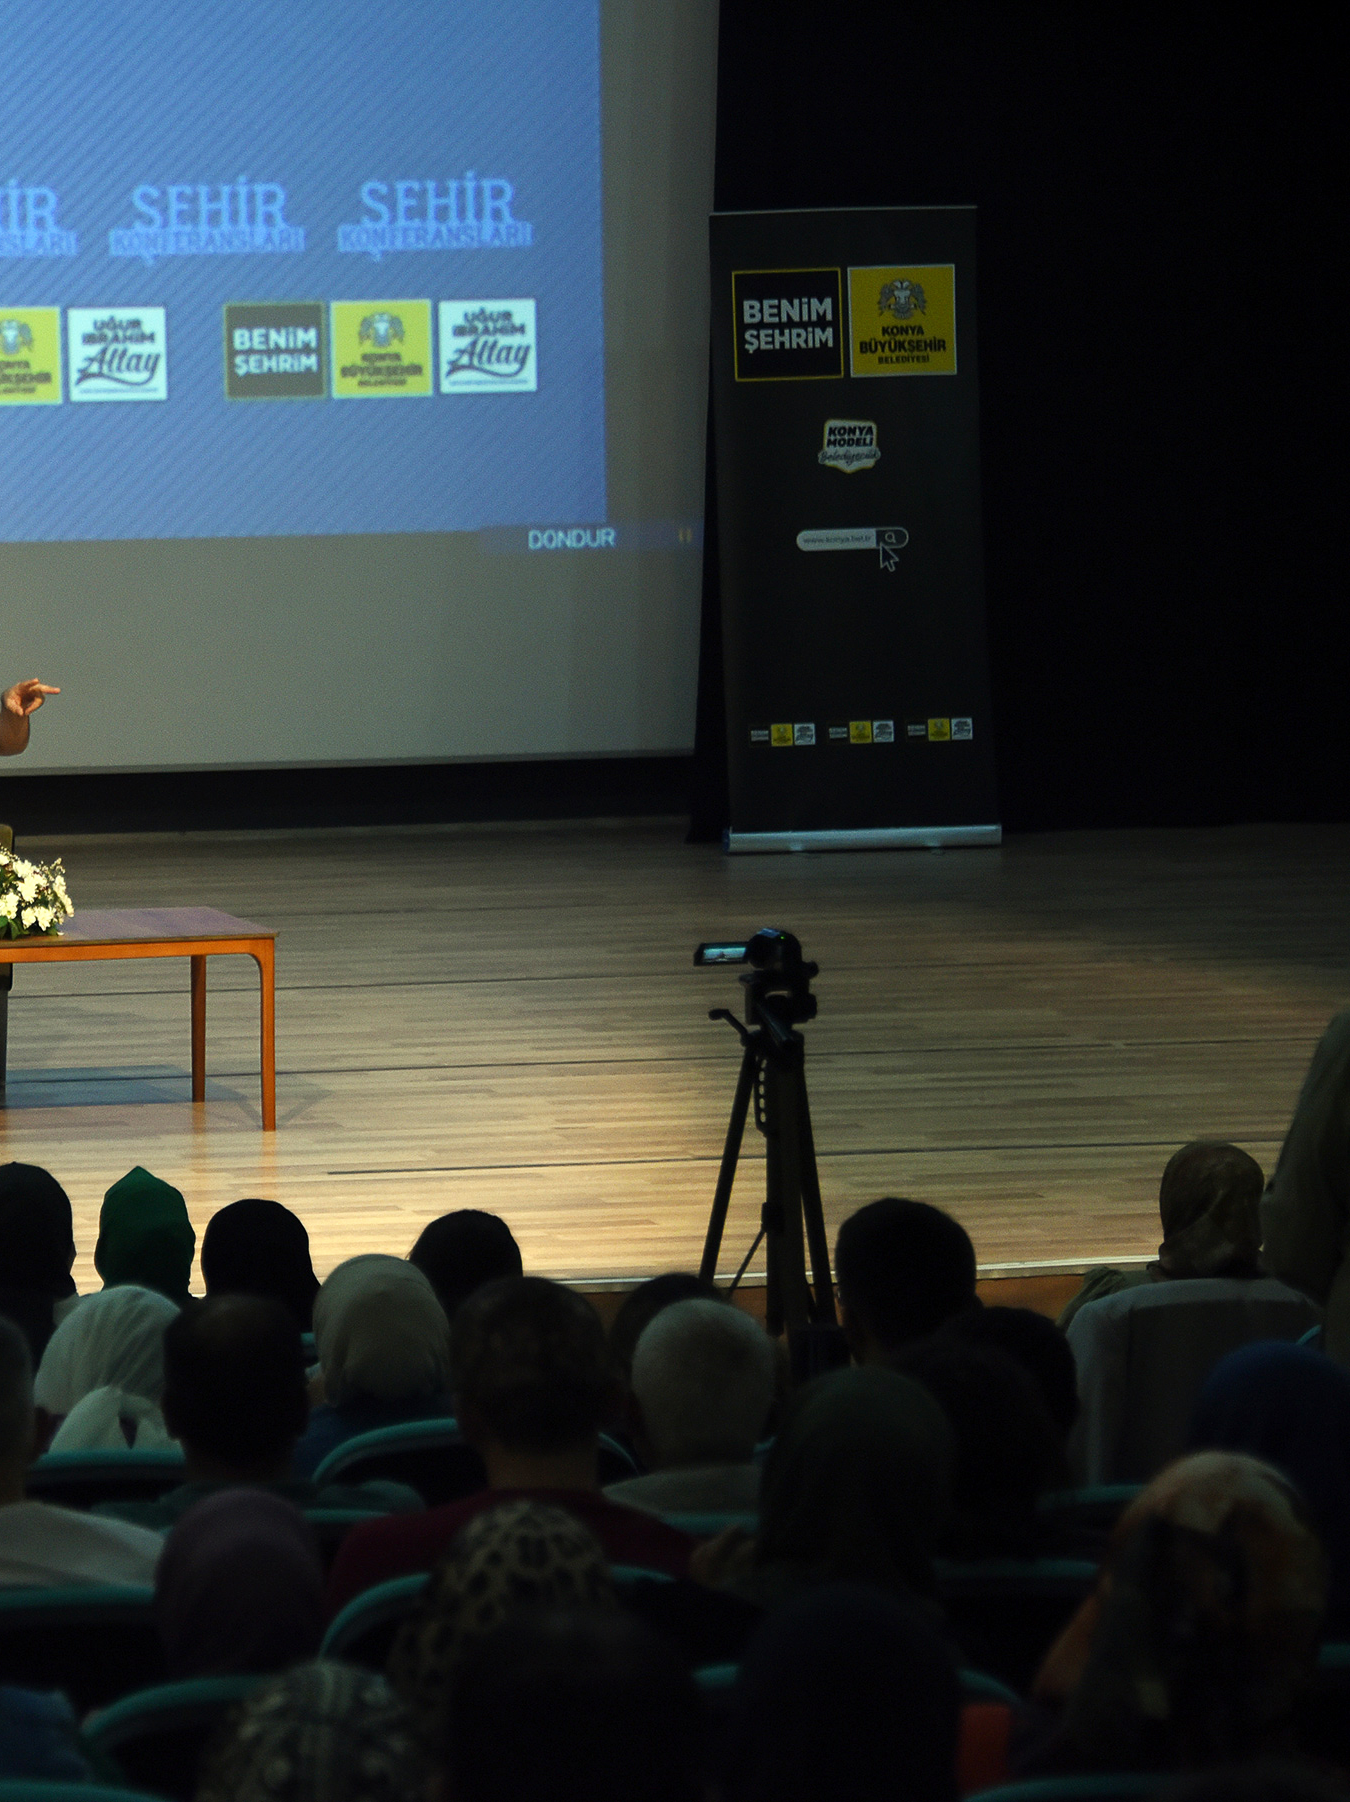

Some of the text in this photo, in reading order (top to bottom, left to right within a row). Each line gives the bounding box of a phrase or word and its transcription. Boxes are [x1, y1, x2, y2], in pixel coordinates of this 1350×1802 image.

[881, 325, 925, 337] KONYA
[828, 426, 874, 437] KONYA
[528, 528, 617, 550] DONDUR
